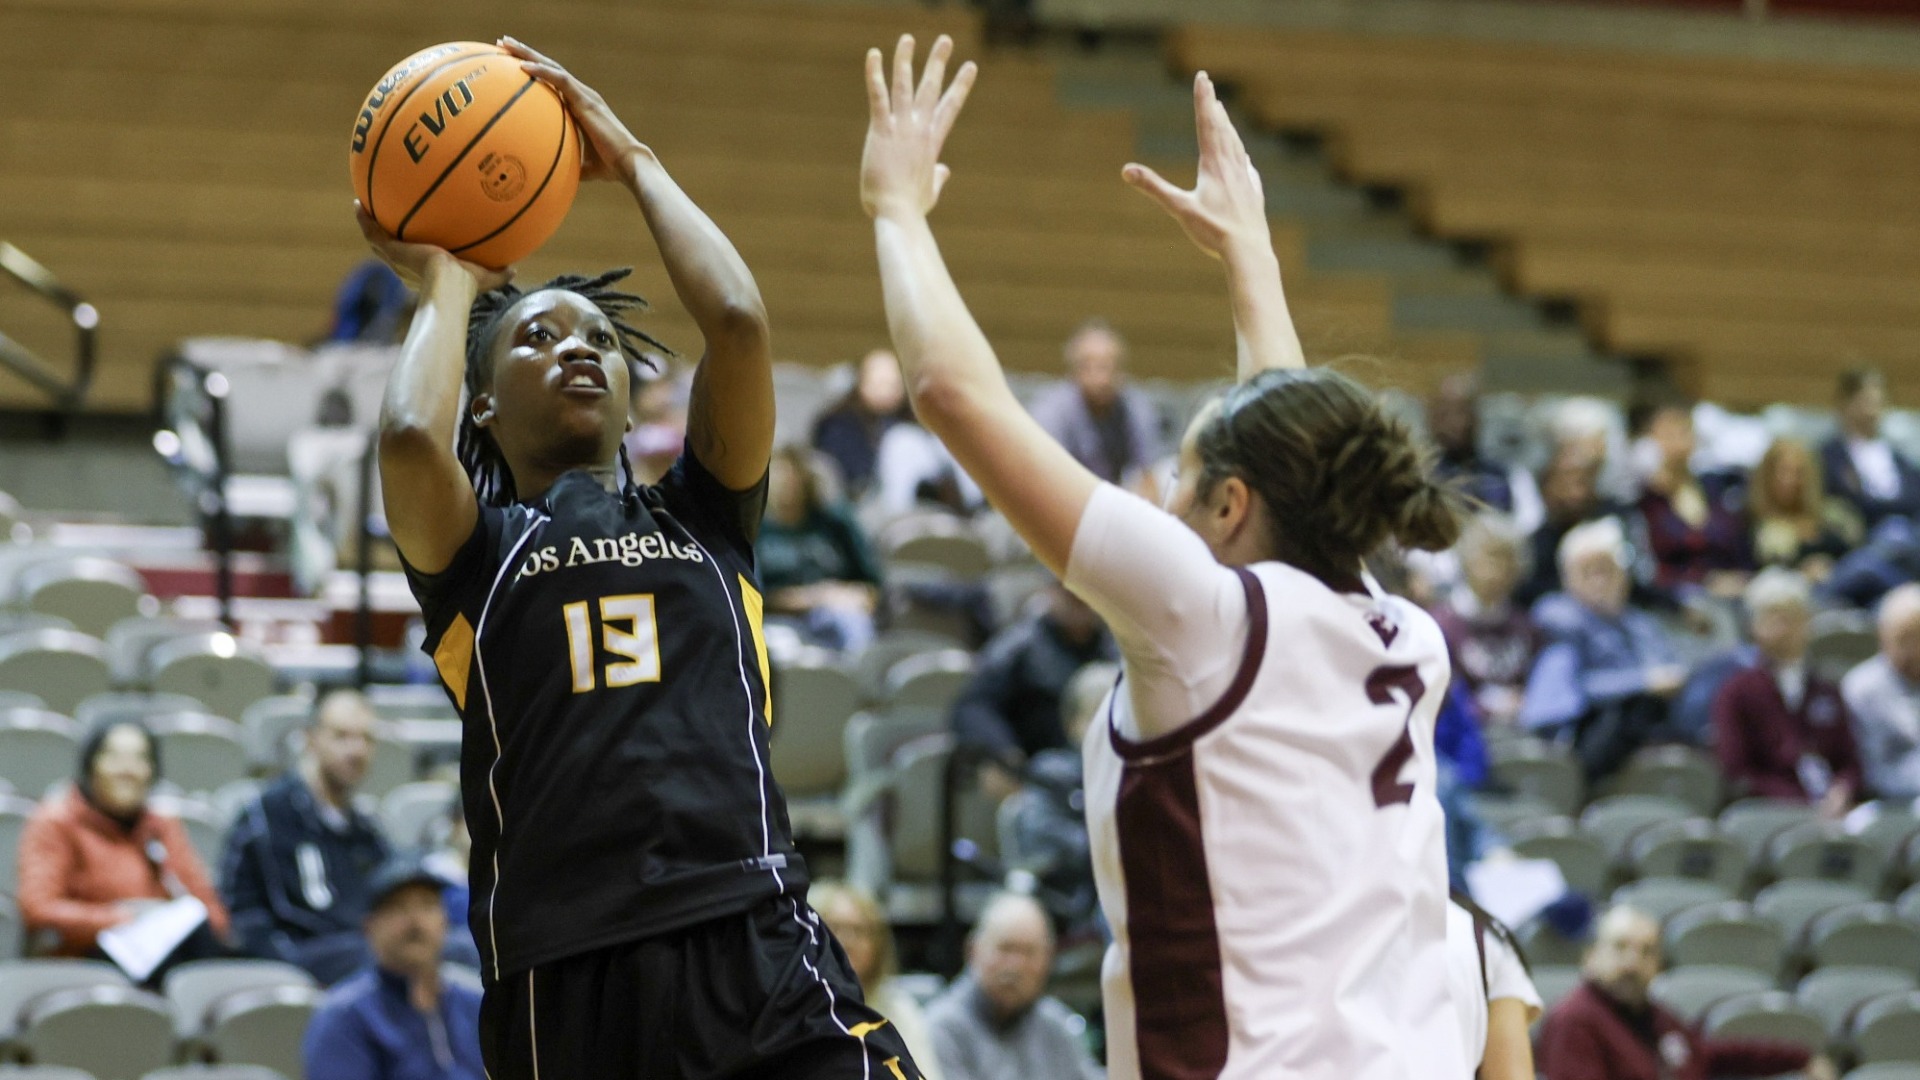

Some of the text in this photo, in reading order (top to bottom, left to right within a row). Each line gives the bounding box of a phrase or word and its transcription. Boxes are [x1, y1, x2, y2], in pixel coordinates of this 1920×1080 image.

[403, 79, 475, 164] EVO
[515, 546, 560, 583] os
[563, 593, 661, 693] 13
[1365, 664, 1426, 810] 2
